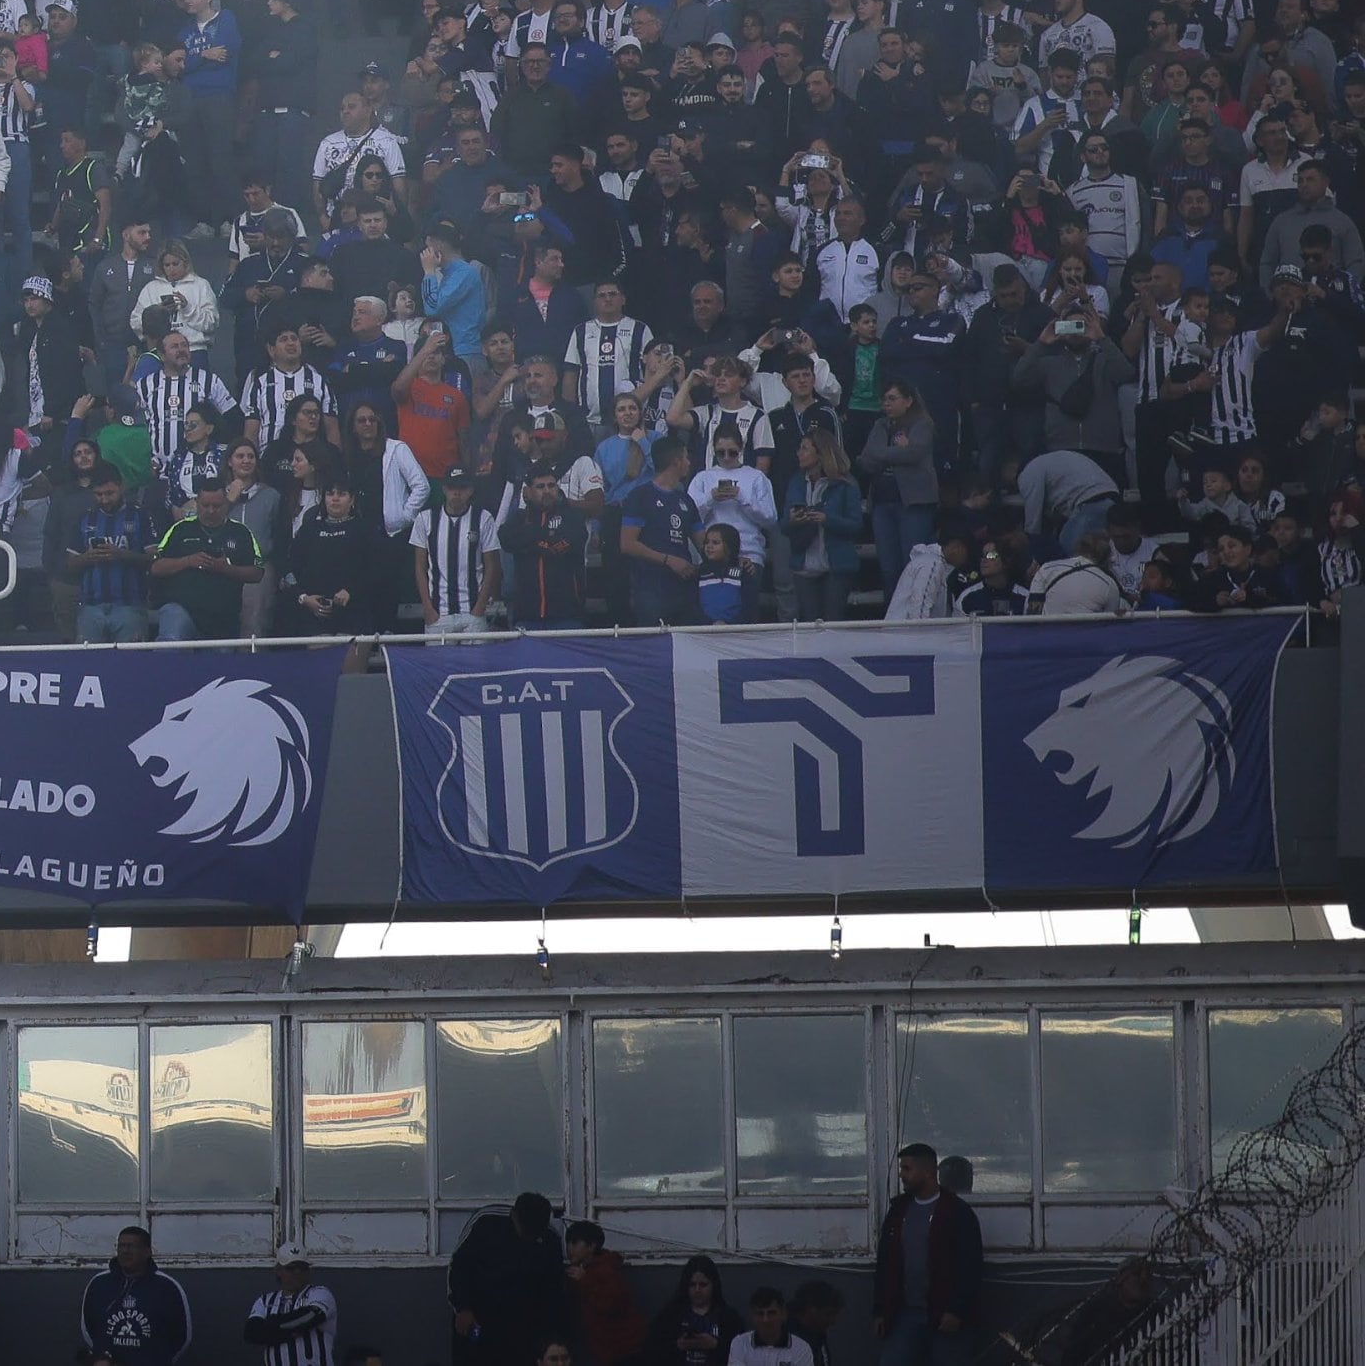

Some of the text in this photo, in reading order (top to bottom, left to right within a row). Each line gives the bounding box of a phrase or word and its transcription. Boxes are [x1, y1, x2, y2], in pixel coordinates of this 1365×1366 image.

[74, 676, 105, 708] A
[481, 680, 574, 705] C.A.T
[113, 1337, 141, 1348] TALLERES
